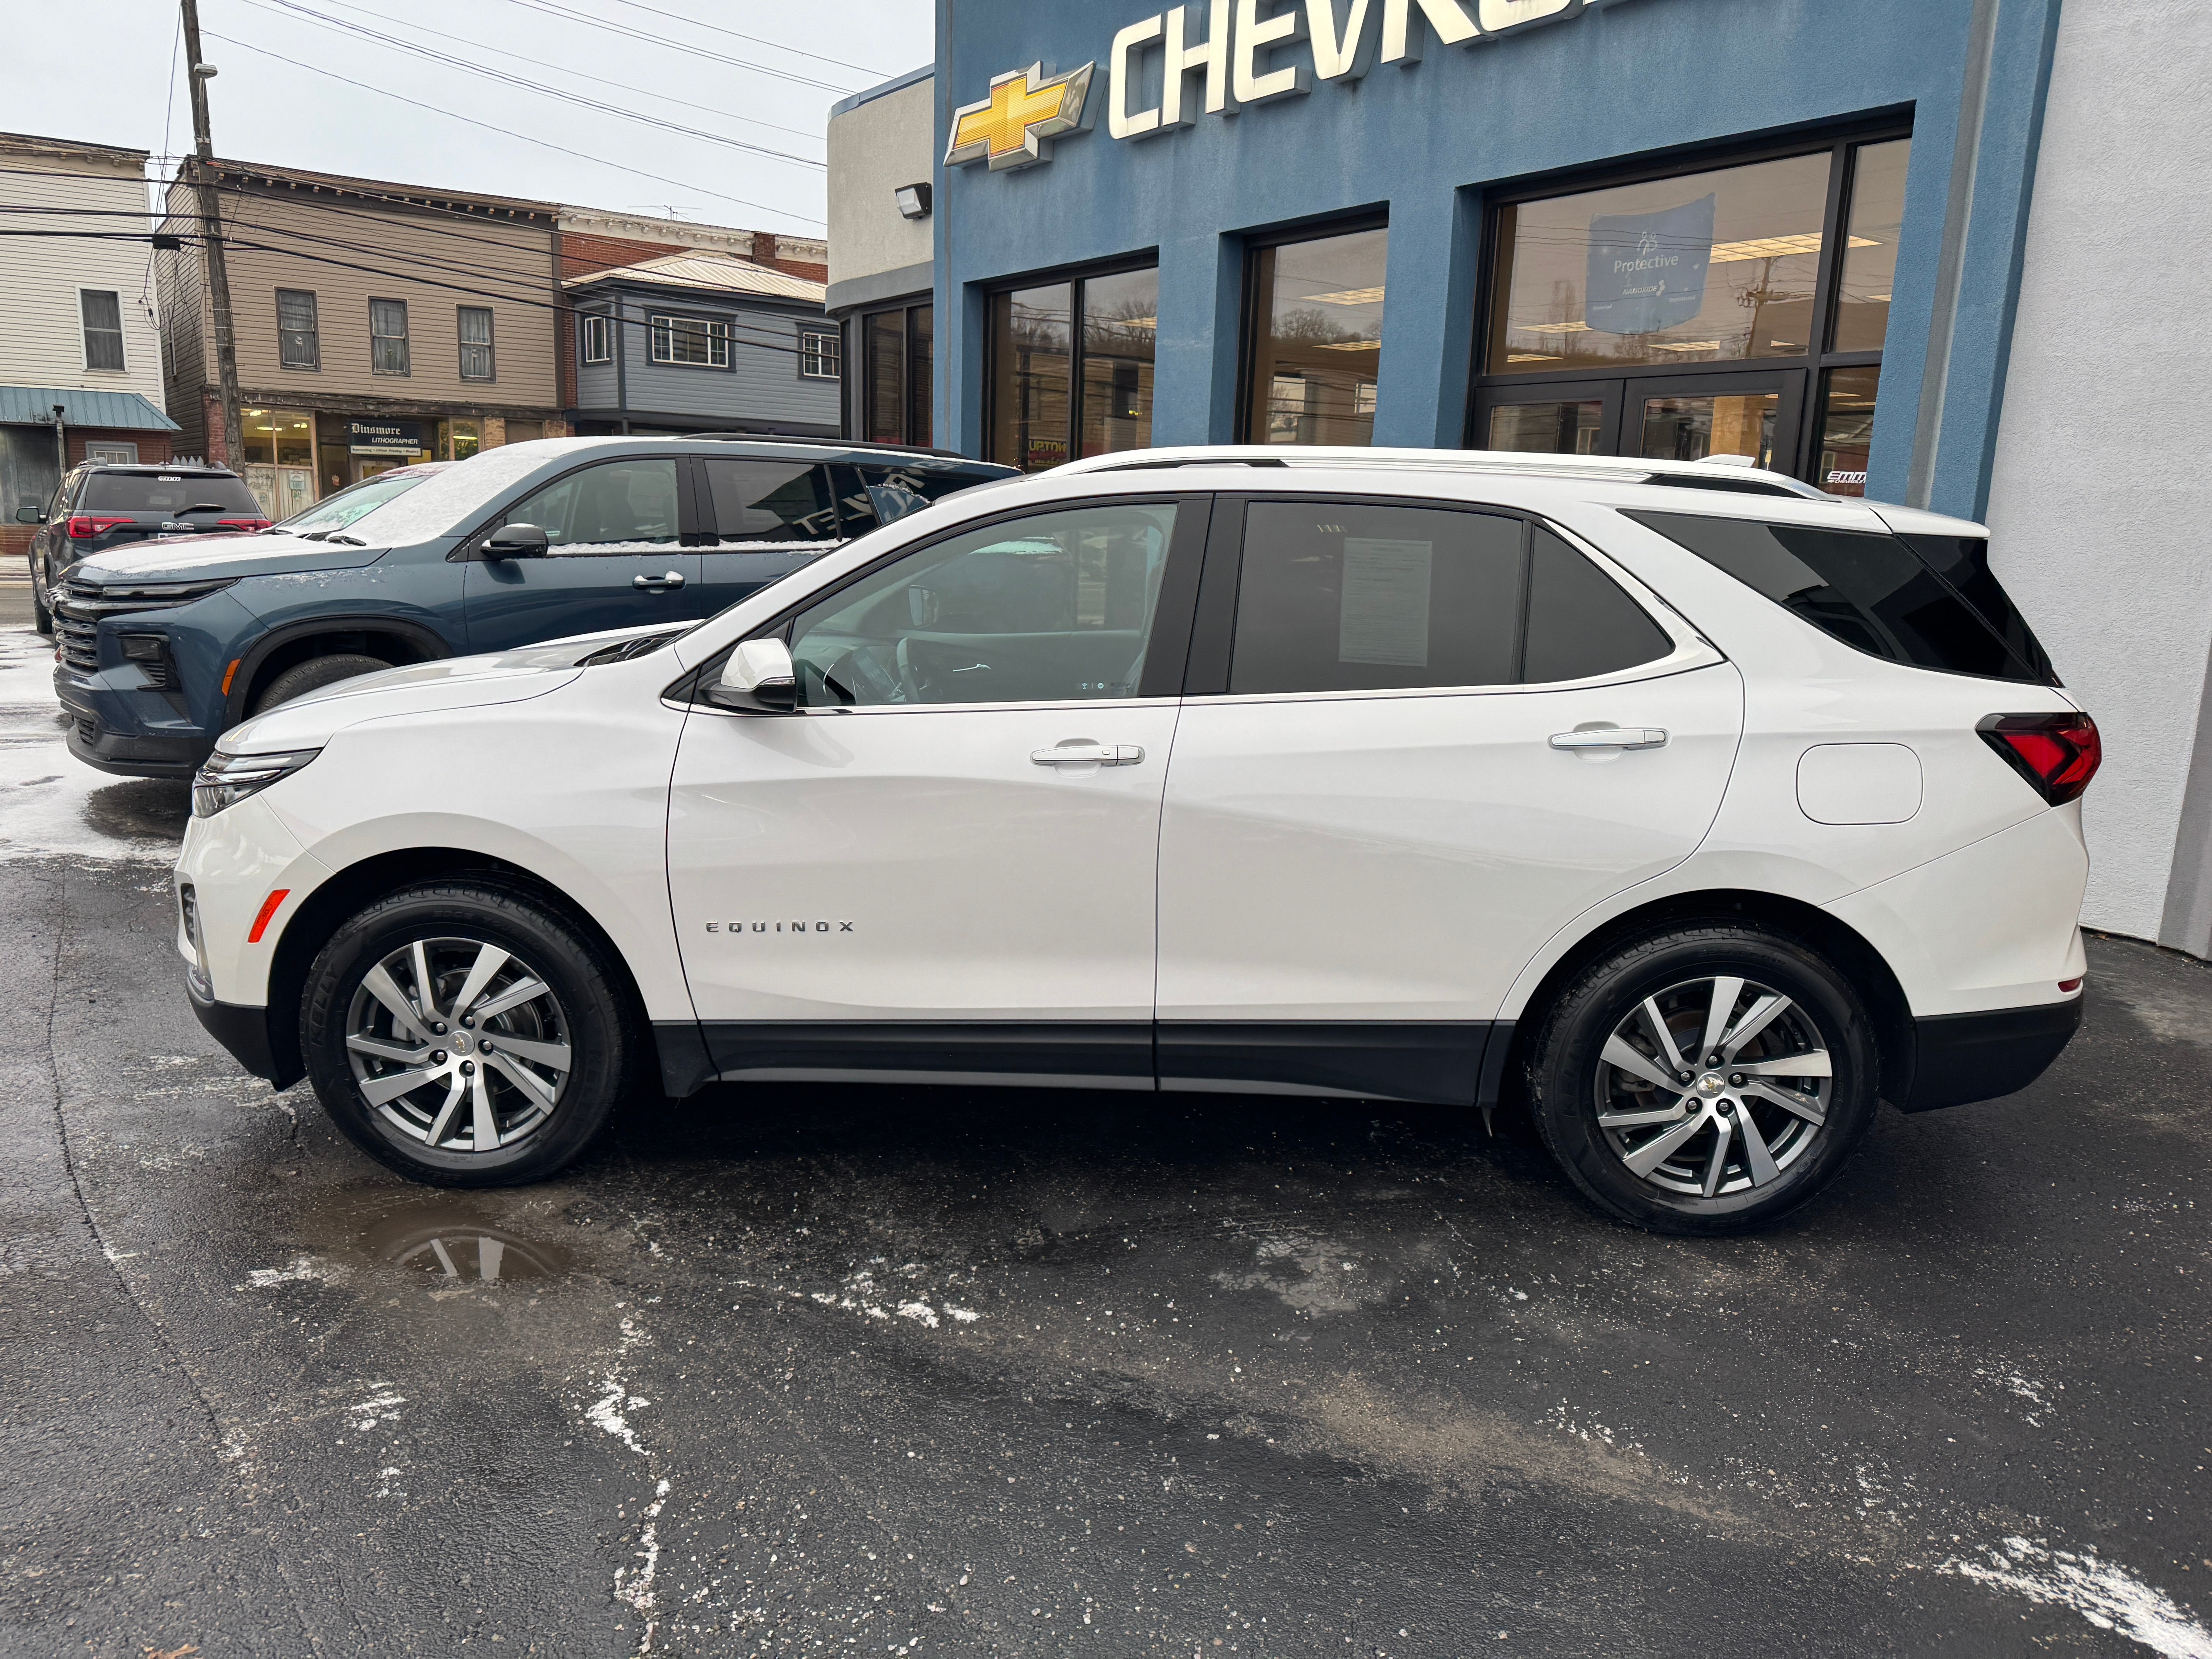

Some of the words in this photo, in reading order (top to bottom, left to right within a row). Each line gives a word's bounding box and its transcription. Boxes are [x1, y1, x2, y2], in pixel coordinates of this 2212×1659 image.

[1614, 254, 1679, 273] Protective
[351, 423, 400, 435] Dinsmore
[162, 522, 194, 531] GMC
[706, 921, 853, 933] EQUINOX
